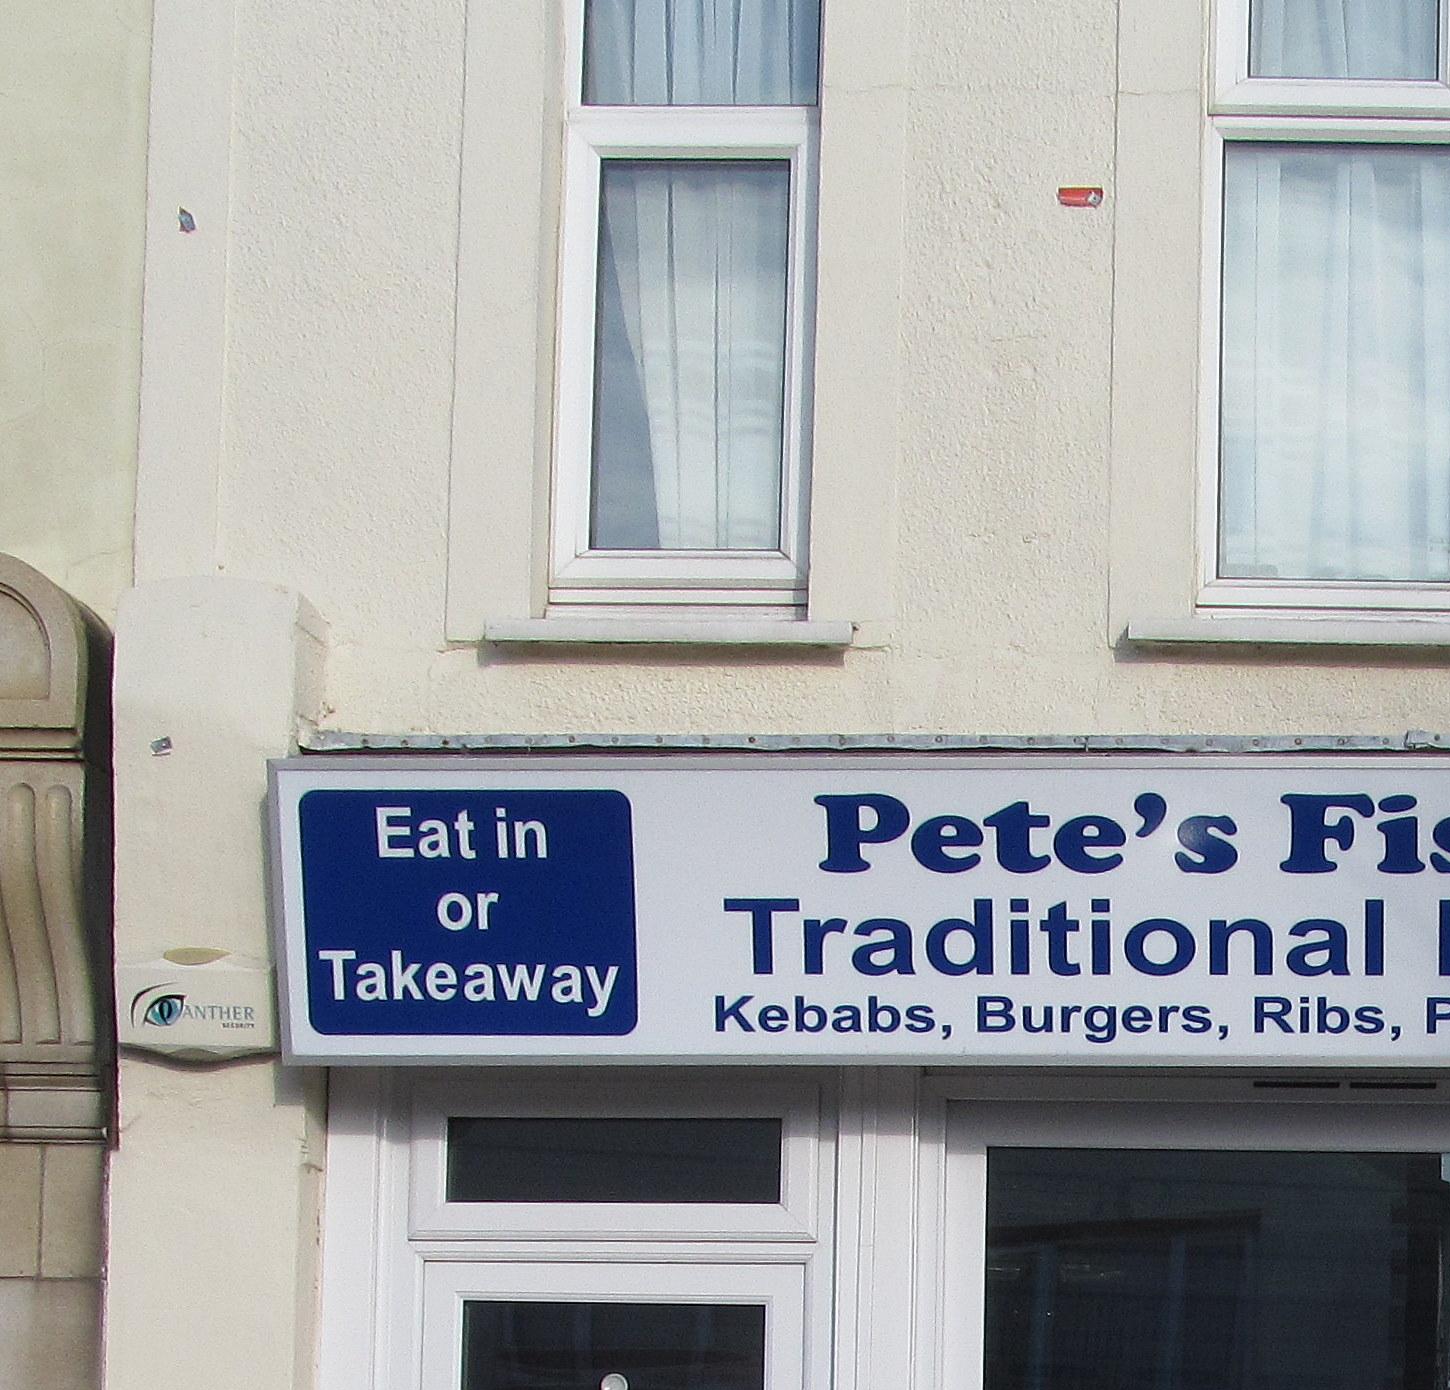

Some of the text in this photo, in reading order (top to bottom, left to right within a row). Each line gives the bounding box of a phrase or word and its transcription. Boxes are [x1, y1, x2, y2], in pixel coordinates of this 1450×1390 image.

[376, 807, 547, 859] Eat in
[814, 793, 1238, 875] Pete's
[437, 892, 499, 931] or
[724, 899, 1385, 977] Traditional
[319, 951, 619, 1017] Takeaway
[715, 996, 952, 1041] Kebabs,
[977, 996, 1229, 1044] Burgers,
[1254, 996, 1401, 1042] Ribs,
